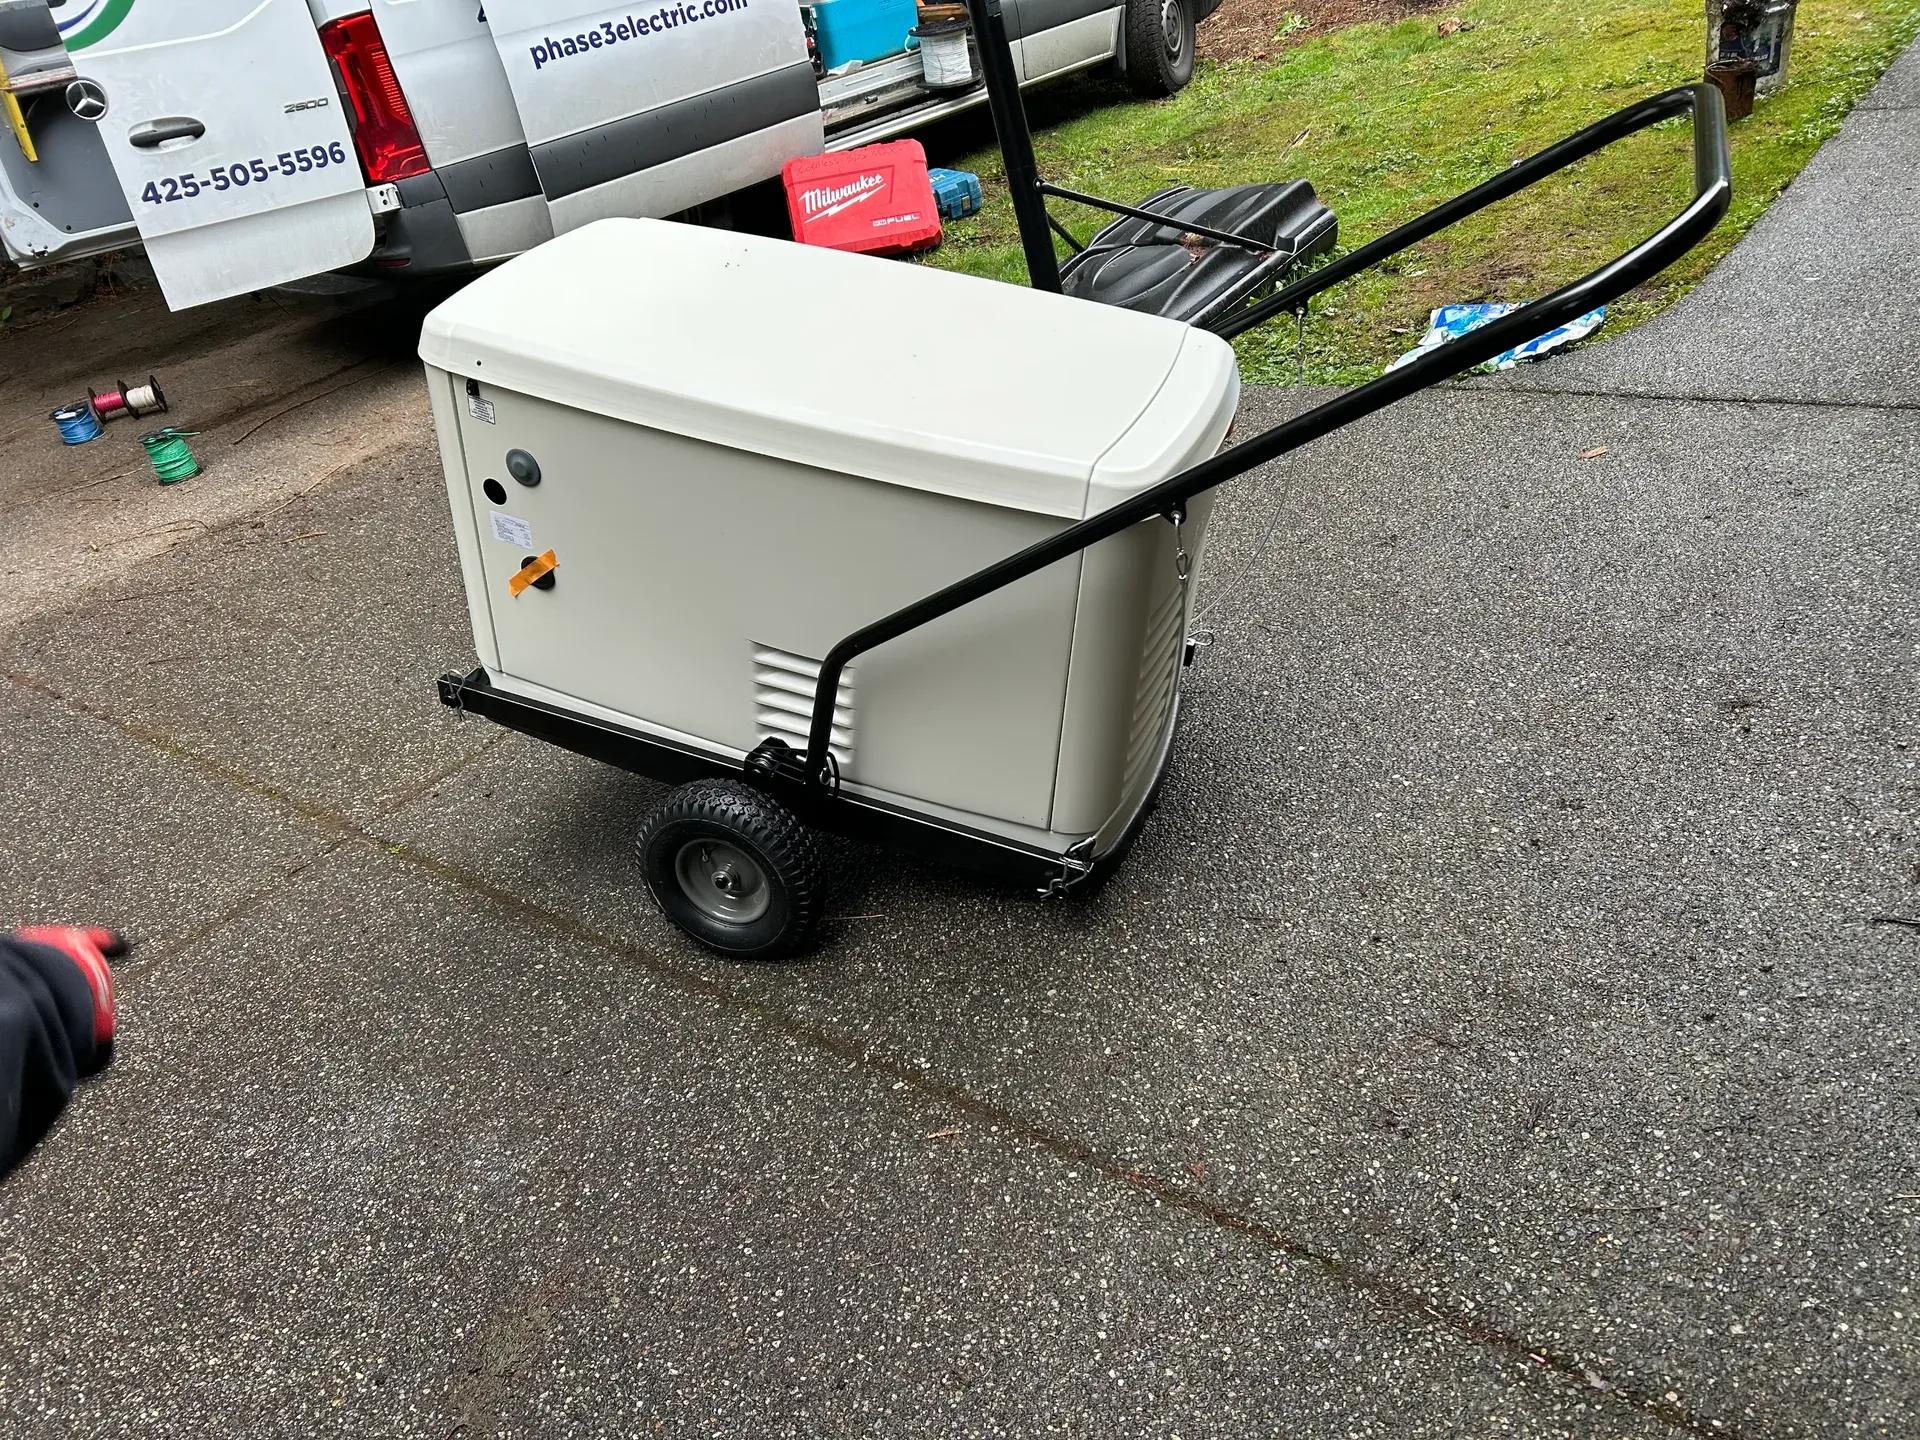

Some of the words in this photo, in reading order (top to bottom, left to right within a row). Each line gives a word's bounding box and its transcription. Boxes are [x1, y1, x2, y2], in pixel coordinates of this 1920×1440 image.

[283, 97, 329, 113] 2500
[141, 141, 346, 205] 425-505-5596
[798, 173, 884, 214] Milwaukee
